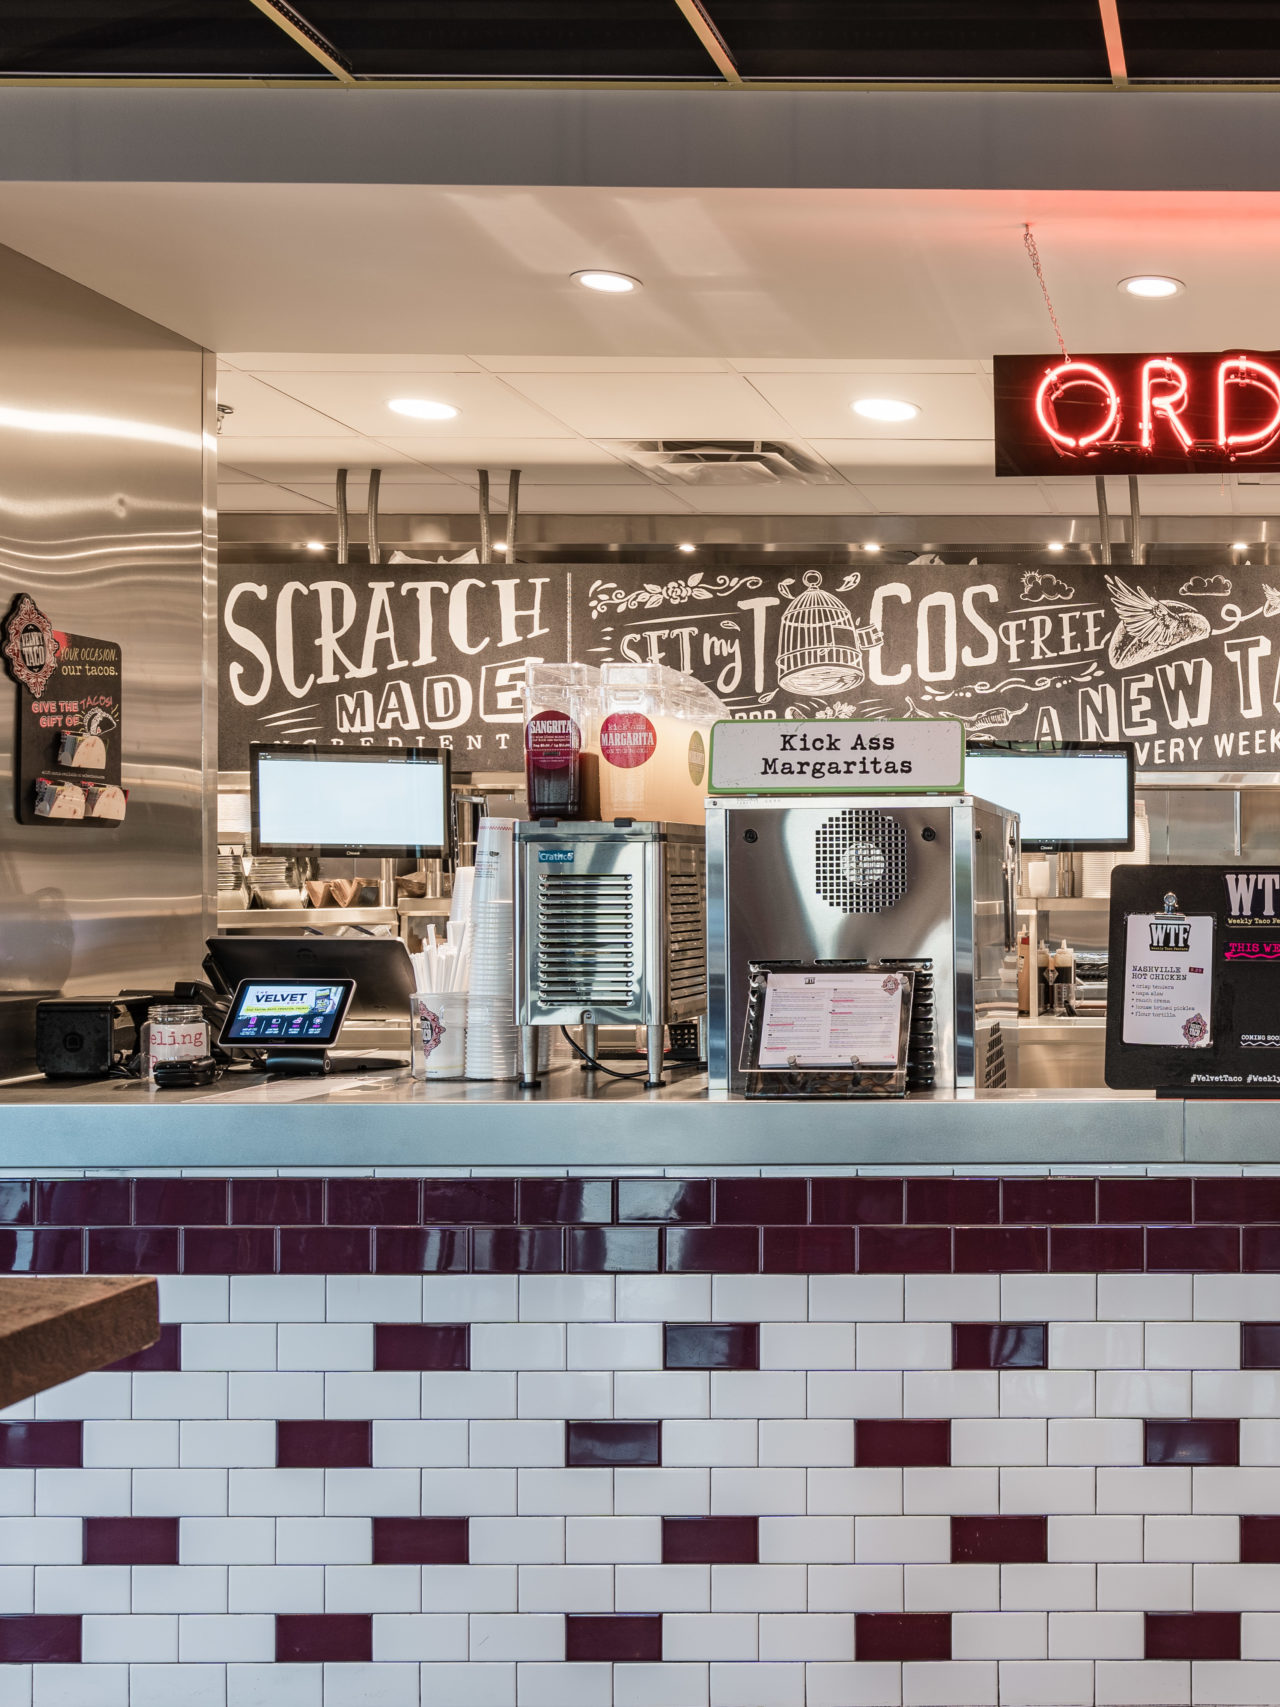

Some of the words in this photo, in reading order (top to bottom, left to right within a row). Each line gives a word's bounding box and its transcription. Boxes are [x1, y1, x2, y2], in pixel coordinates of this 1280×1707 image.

[21, 631, 44, 648] VELVET
[224, 577, 550, 706] SCRATCH
[22, 646, 45, 668] TACO
[60, 646, 80, 661] YOUR
[80, 647, 118, 662] OCCASION.
[703, 633, 742, 693] my
[999, 608, 1110, 664] FREE
[61, 664, 82, 676] our
[85, 664, 118, 676] tacos.
[336, 656, 544, 734] MADE
[1034, 706, 1063, 741] A
[1079, 657, 1213, 742] NEW
[31, 700, 57, 714] GIVE
[58, 700, 79, 714] THE
[79, 696, 113, 711] TACOS!
[39, 715, 64, 728] GIFT
[65, 715, 80, 728] OF
[530, 720, 572, 734] SANGRITA
[601, 732, 655, 746] MARGARITA
[780, 733, 841, 751] Kick
[850, 733, 895, 751] Ass
[1136, 735, 1204, 766] VERY
[760, 757, 913, 779] Margaritas
[1228, 917, 1252, 925] Weekly
[1151, 924, 1190, 946] WTF
[1229, 943, 1259, 953] THIS
[255, 993, 307, 1003] VELVET
[150, 1031, 204, 1047] eling
[1190, 1075, 1243, 1083] #VelvetTaco
